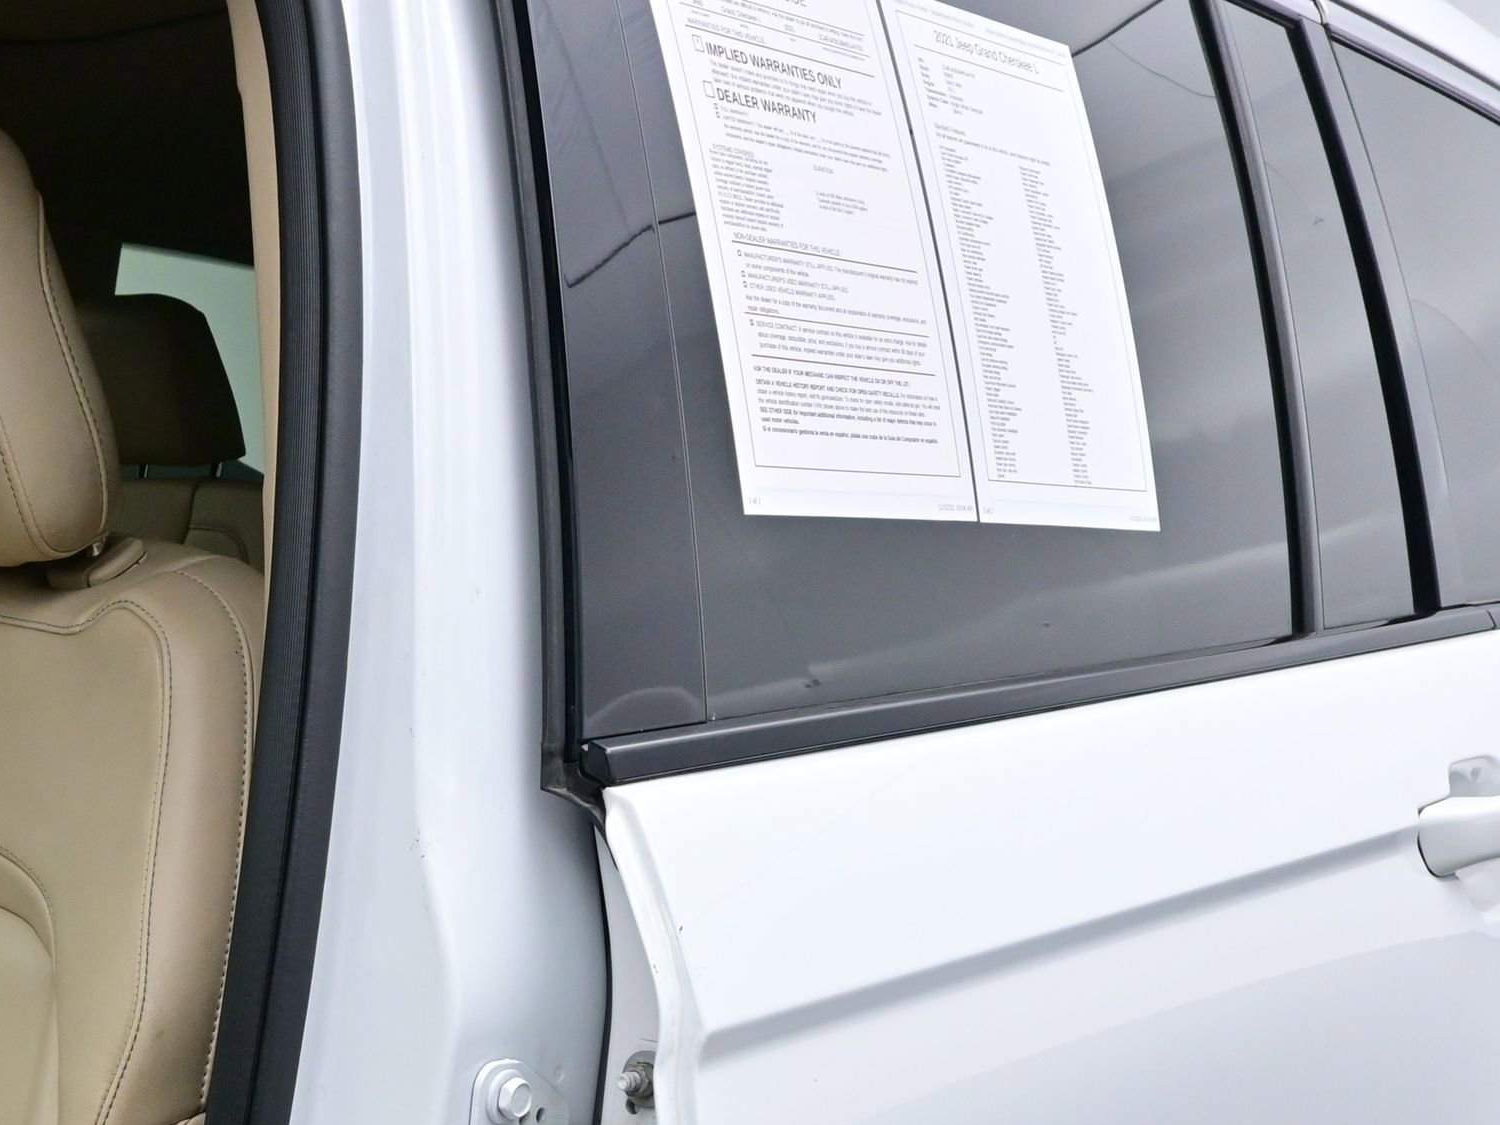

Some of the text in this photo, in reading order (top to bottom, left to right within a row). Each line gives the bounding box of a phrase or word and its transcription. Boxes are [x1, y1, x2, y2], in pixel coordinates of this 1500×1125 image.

[705, 41, 843, 90] IMPLIED WARRANTIES ONLY
[932, 29, 953, 49] 2021
[954, 35, 974, 55] Jeep
[973, 41, 998, 63] Grand
[997, 49, 1033, 74] Cherokee
[715, 87, 759, 110] DEALER
[759, 97, 817, 124] WARRANTY
